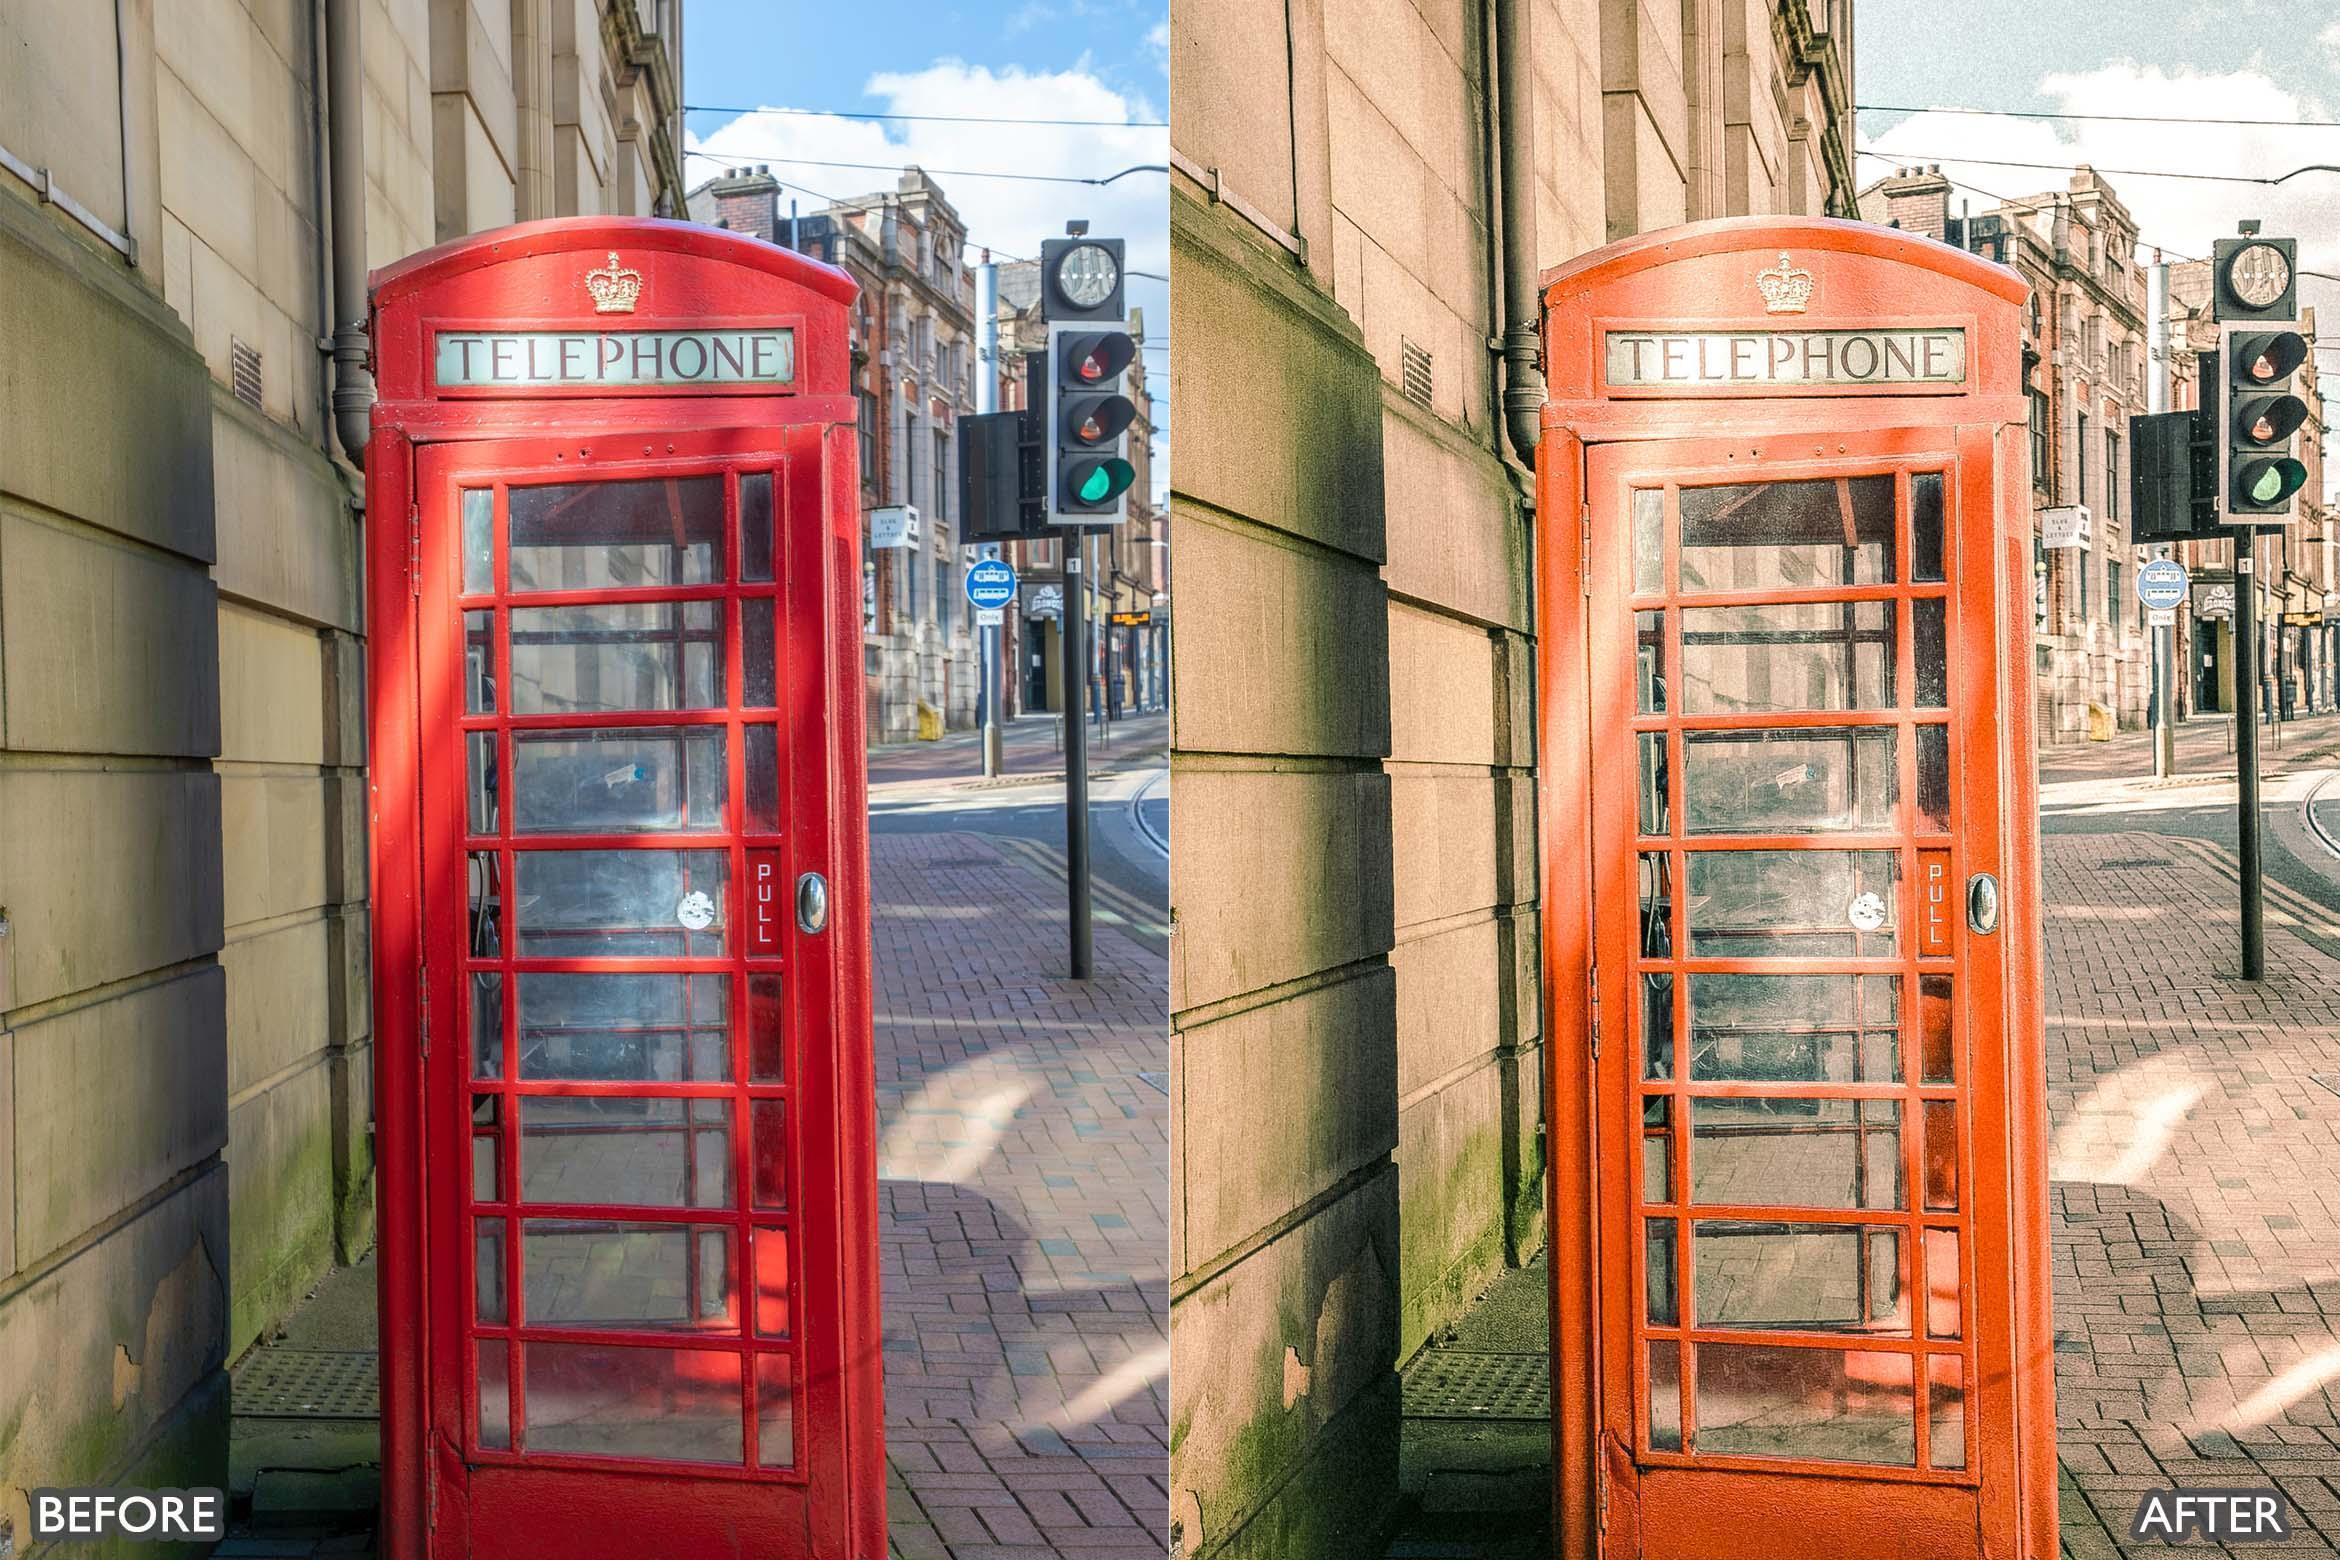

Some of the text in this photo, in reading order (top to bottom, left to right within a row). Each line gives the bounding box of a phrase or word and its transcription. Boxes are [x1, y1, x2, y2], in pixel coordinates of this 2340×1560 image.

[449, 335, 778, 381] TELEPHONE
[1619, 335, 1949, 380] TELEPHONE
[758, 864, 772, 943] PULL
[1929, 864, 1943, 944] PULL
